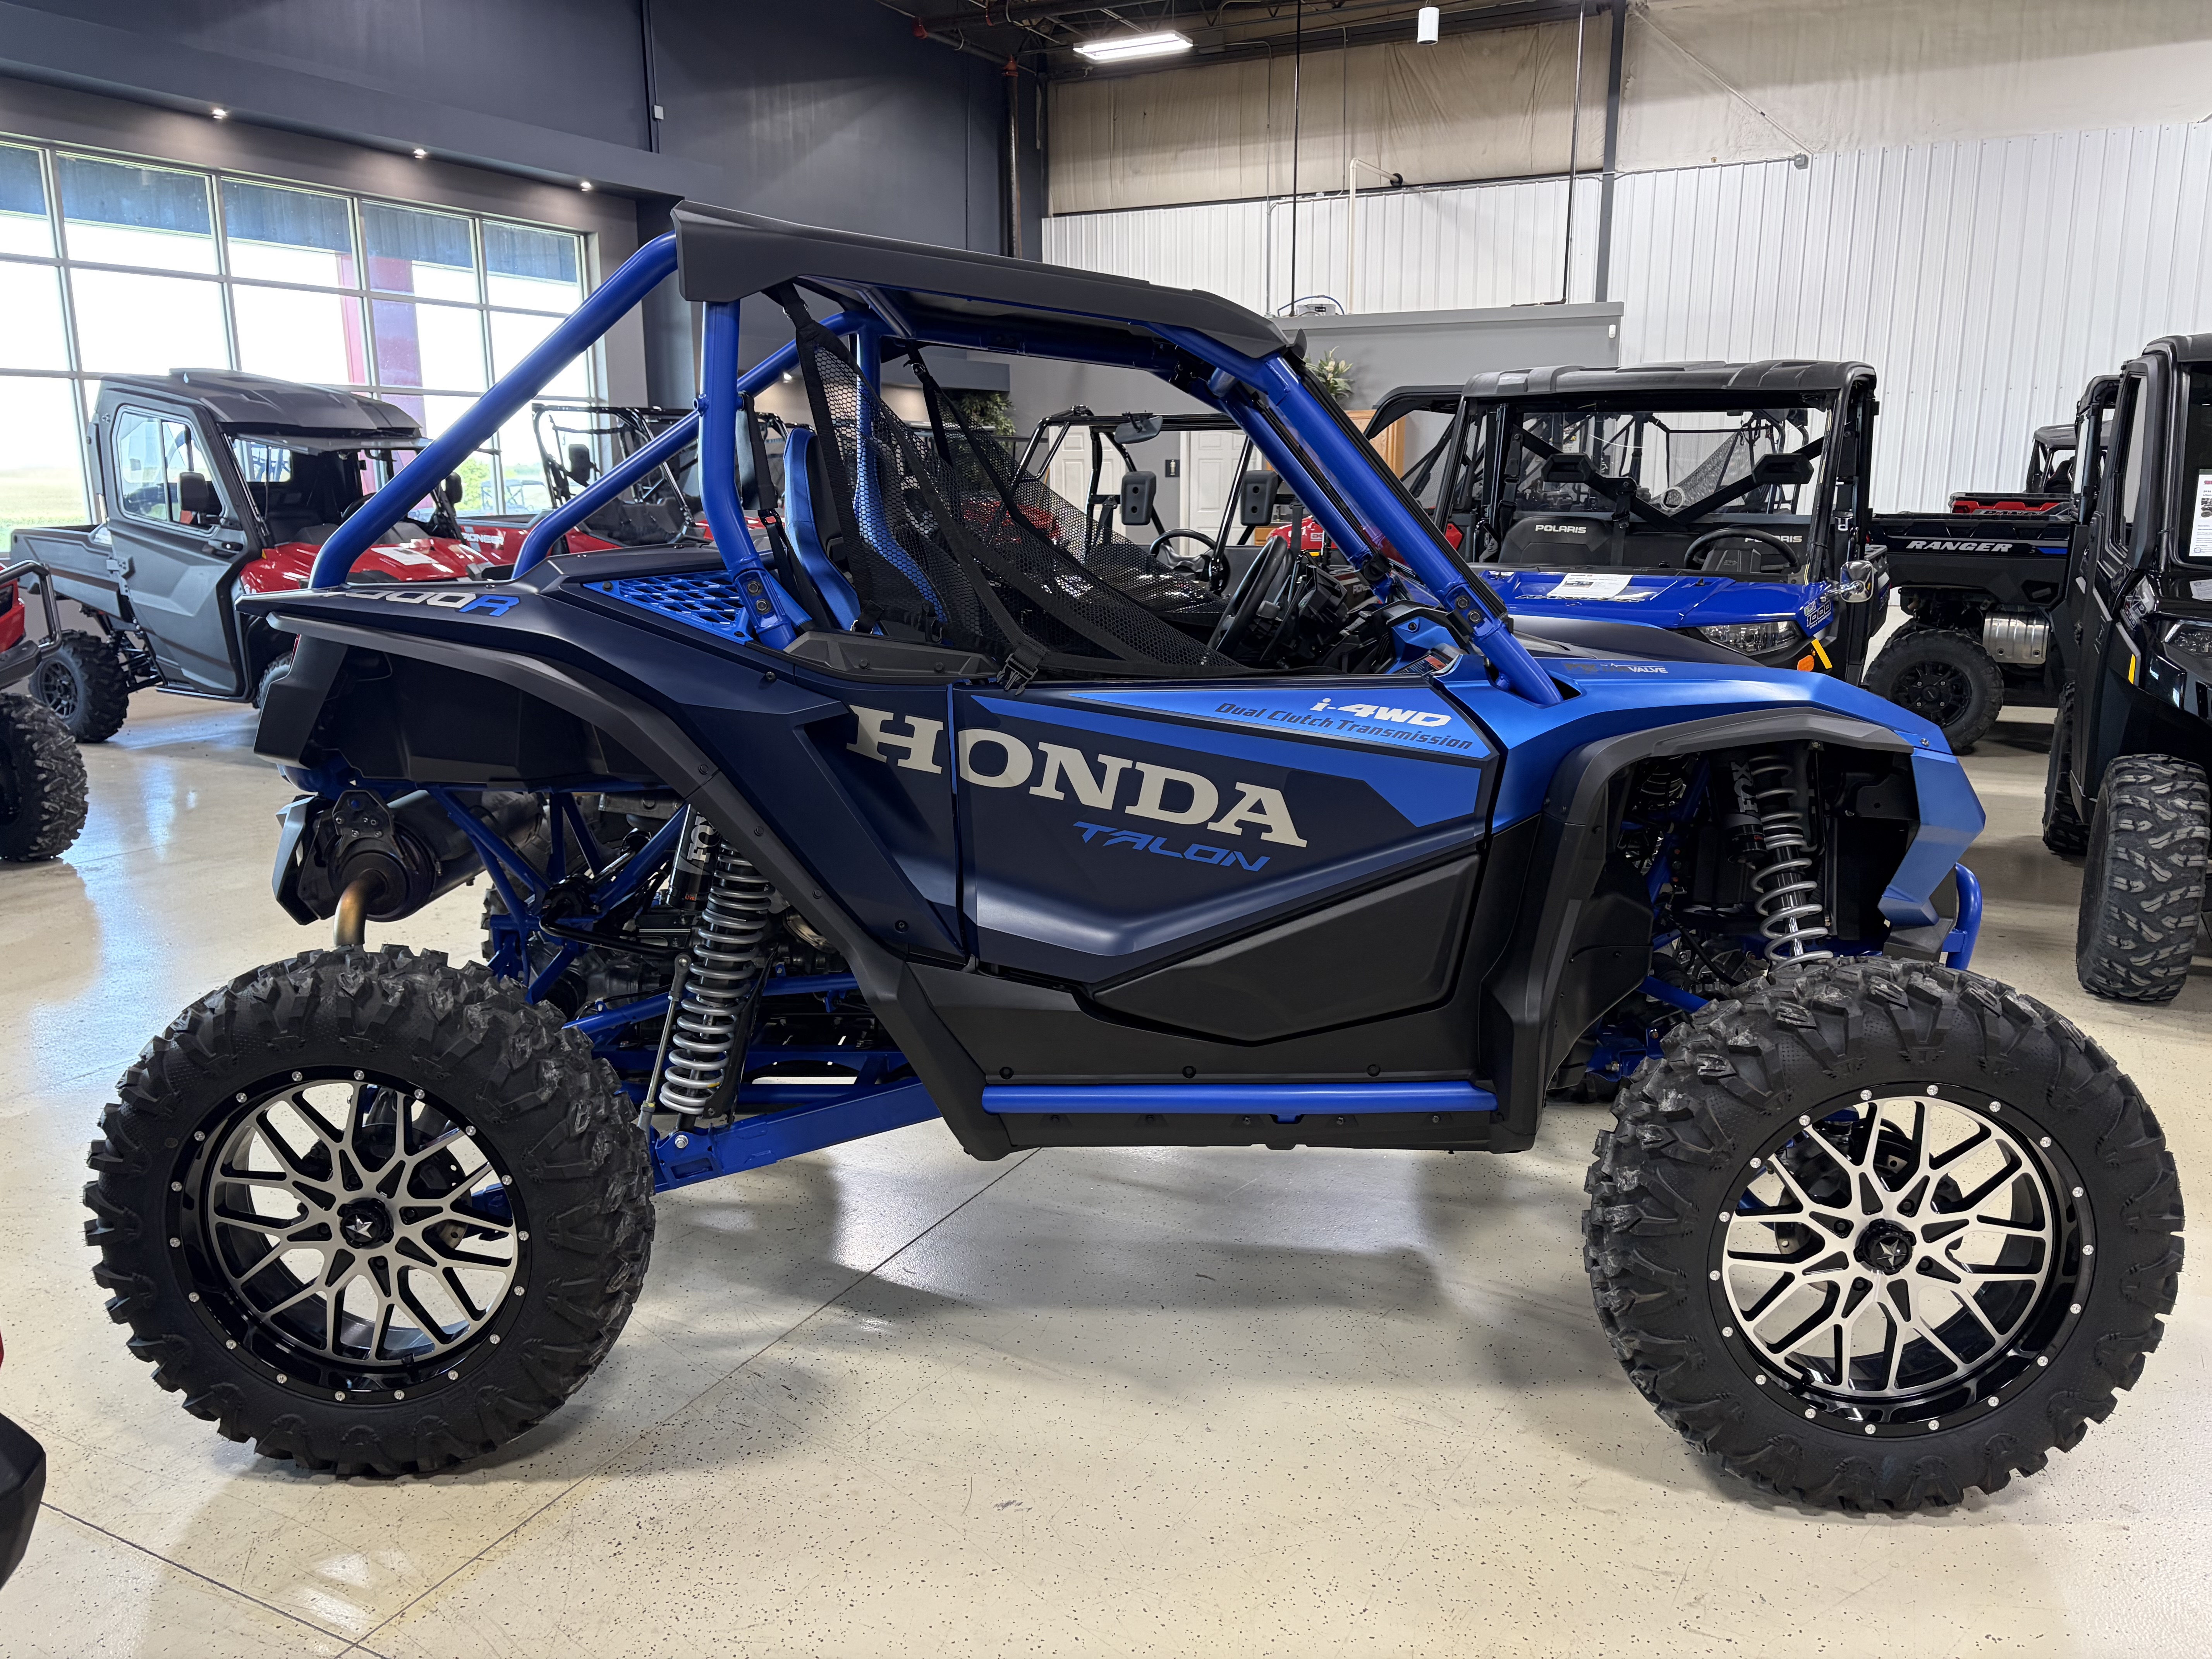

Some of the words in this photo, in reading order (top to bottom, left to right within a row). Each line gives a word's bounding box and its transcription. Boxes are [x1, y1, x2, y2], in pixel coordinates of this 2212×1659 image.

[461, 532, 504, 545] PIONEER
[1535, 525, 1587, 534] POLARIS
[1906, 541, 2013, 552] RANGER
[1806, 599, 1832, 627] 1000
[1214, 703, 1267, 718] Dual
[1267, 710, 1333, 728] Clutch
[1336, 719, 1473, 750] Transmission
[846, 704, 1307, 848] HONDA
[1073, 821, 1271, 872] TALON
